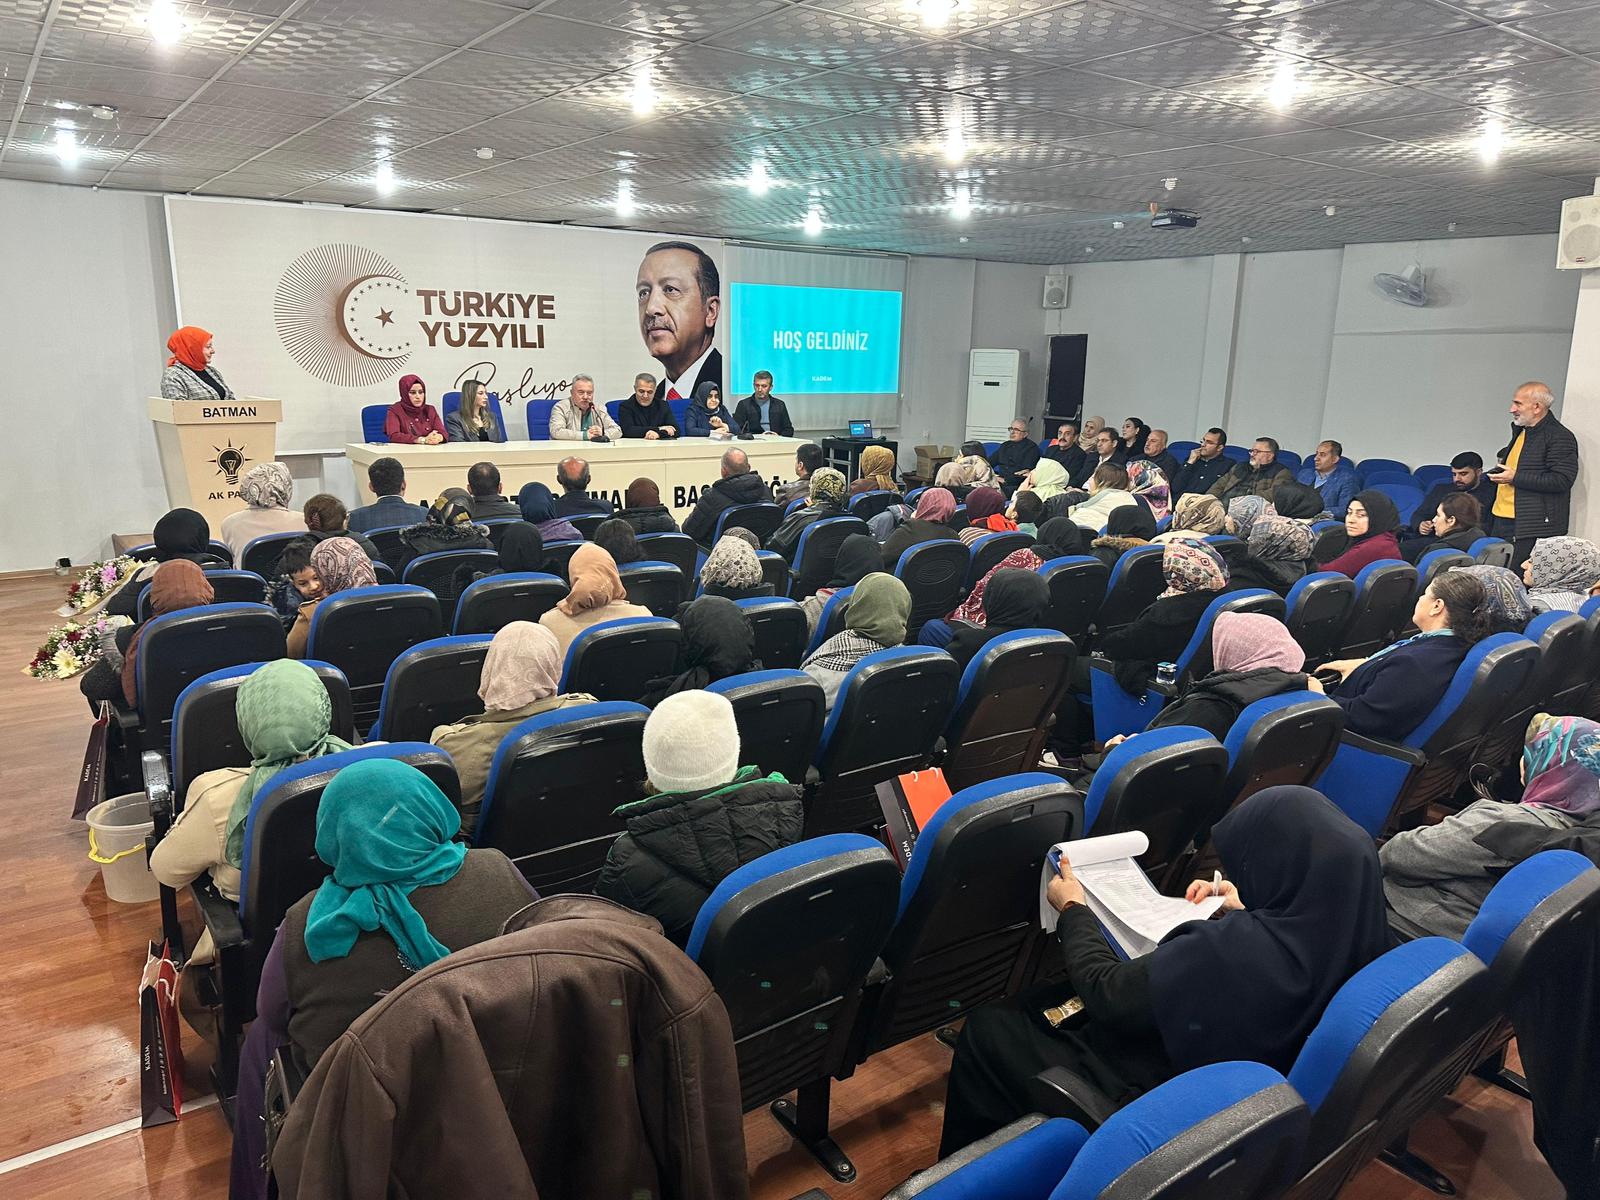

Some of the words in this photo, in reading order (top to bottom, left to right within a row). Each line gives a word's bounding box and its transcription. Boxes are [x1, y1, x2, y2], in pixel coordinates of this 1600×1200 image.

[416, 289, 556, 320] TÜRKİYE
[418, 321, 545, 349] YÜZYILI
[773, 330, 802, 353] HOŞ
[806, 329, 869, 351] GELDİNİZ
[202, 406, 257, 418] BATMAN
[208, 491, 225, 500] AK
